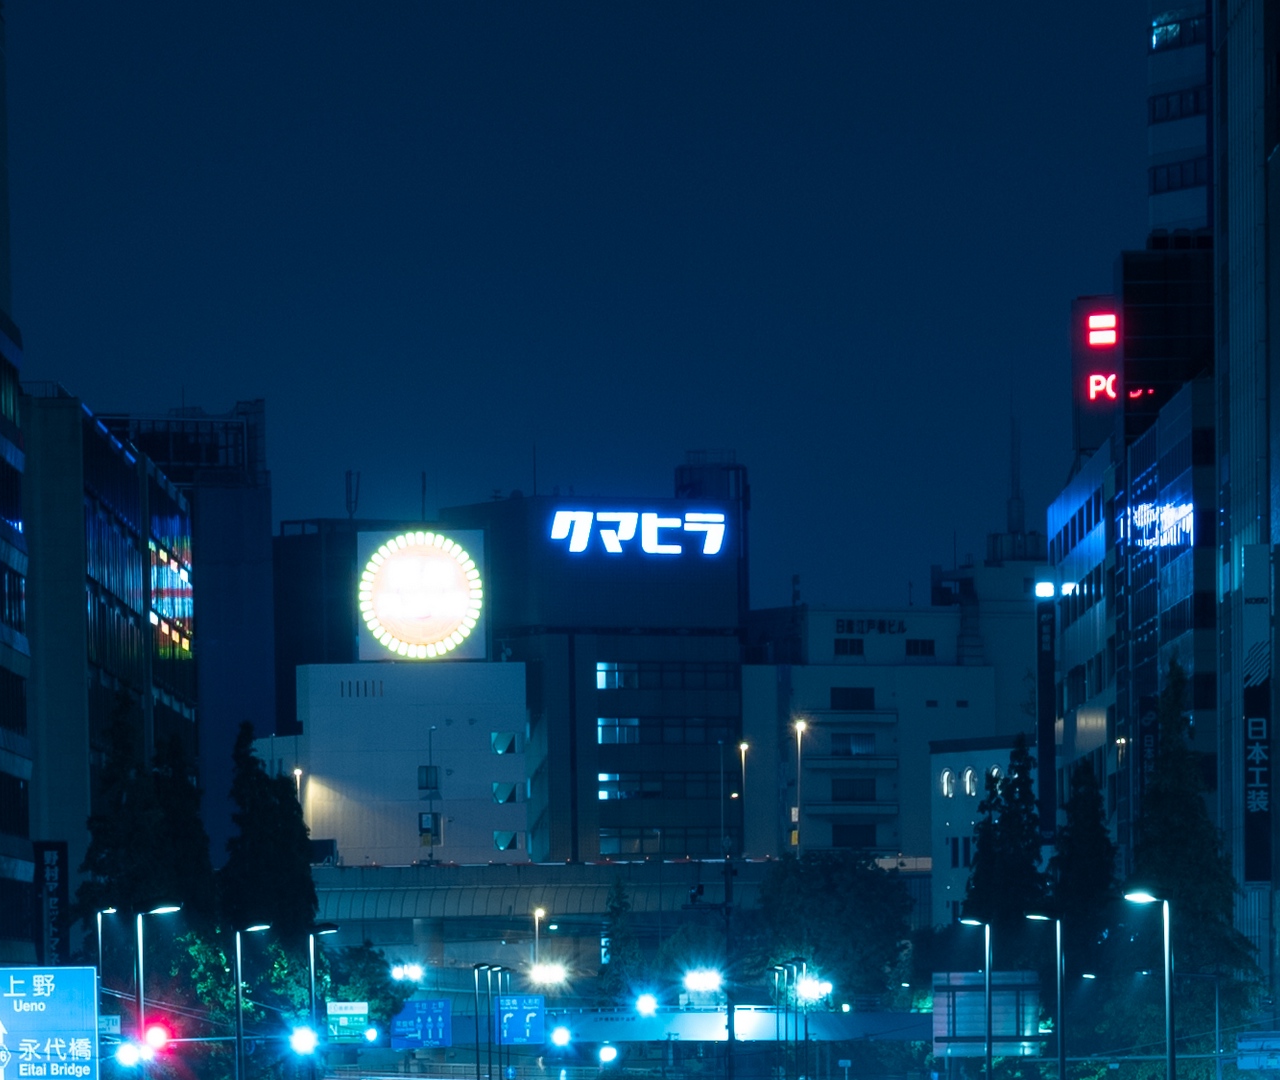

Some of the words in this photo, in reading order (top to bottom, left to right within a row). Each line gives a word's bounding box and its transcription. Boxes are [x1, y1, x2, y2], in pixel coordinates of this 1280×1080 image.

[550, 510, 726, 555] クマヒラ
[1246, 717, 1269, 813] 日本工装
[3, 974, 55, 998] 上野
[13, 1000, 46, 1013] Ueno
[18, 1037, 92, 1062] 永代橋
[19, 1063, 47, 1076] Eitai
[50, 1063, 91, 1077] Bridge
